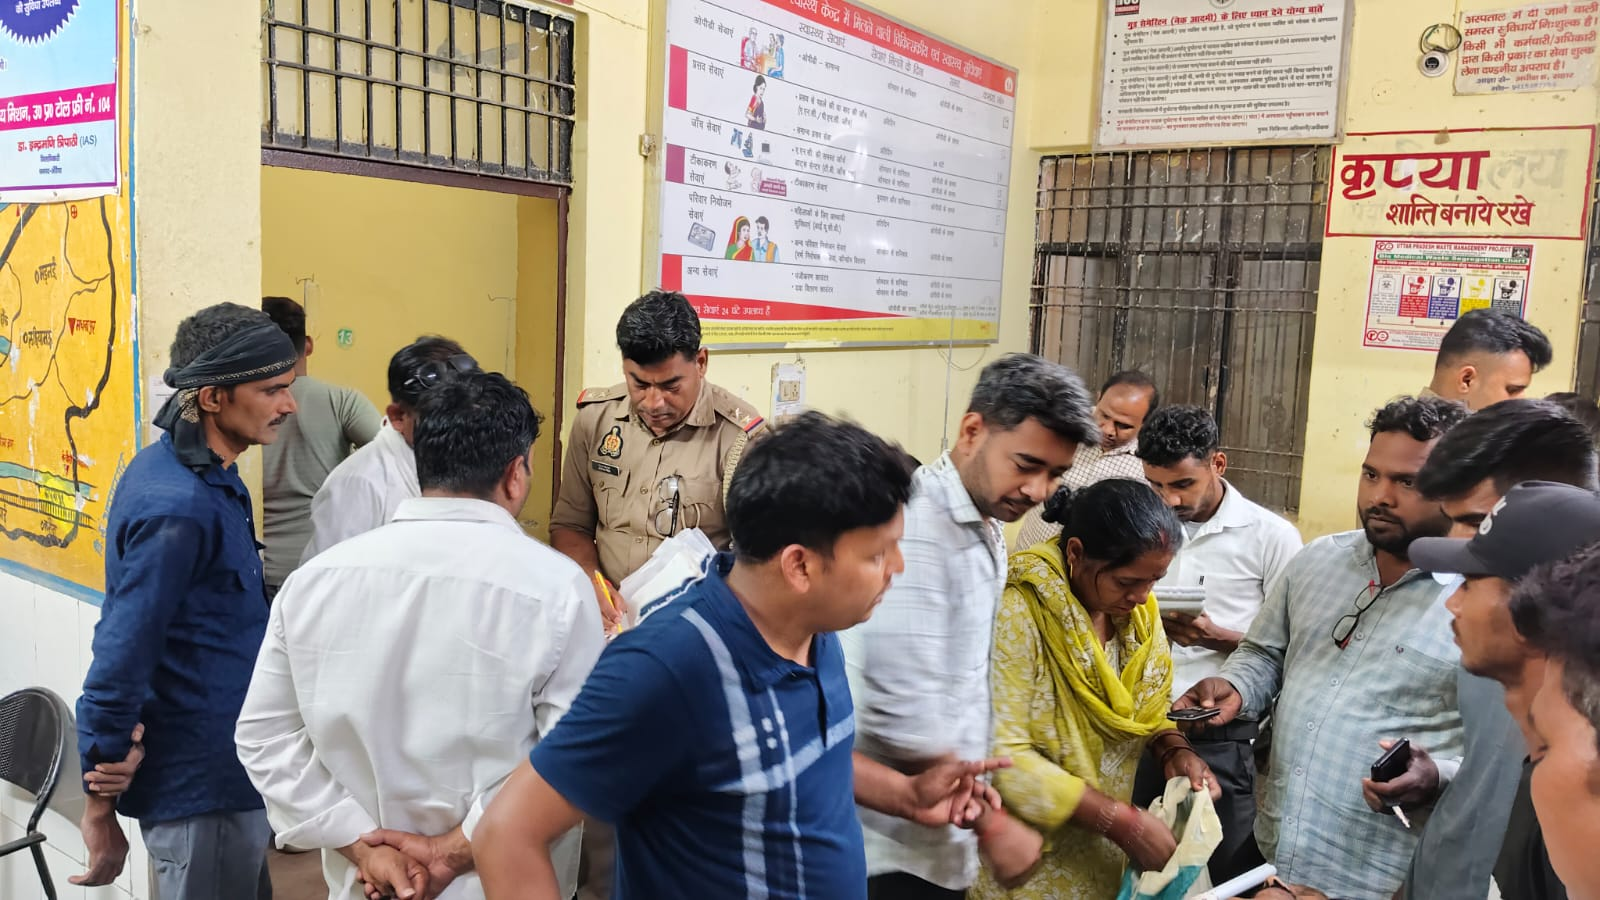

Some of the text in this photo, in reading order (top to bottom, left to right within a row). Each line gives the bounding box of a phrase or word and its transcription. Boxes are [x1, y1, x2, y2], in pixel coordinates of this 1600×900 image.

[1127, 21, 1138, 30] गुड
[1190, 13, 1217, 24] आदमी)
[1221, 11, 1229, 20] के
[1231, 11, 1247, 20] लिए
[1465, 13, 1506, 24] अस्पताल
[1544, 5, 1568, 16] जाने
[1574, 1, 1599, 13] वाली
[799, 22, 824, 40] स्वास्थ्य
[820, 1, 840, 23] केन्द्र
[853, 11, 873, 36] मिलने
[875, 23, 891, 44] वाली
[1464, 26, 1495, 37] समस्त
[1463, 40, 1486, 51] किसी
[1494, 38, 1505, 49] भी
[1462, 54, 1479, 64] द्वारा
[1481, 51, 1504, 63] किसी
[1534, 49, 1547, 58] का
[1550, 46, 1568, 57] सेवा
[1570, 46, 1595, 59] शुल्क
[1461, 66, 1479, 76] लेना
[1520, 62, 1551, 73] अपराध
[55, 97, 70, 118] टोल
[72, 94, 84, 117] फ्री
[98, 96, 111, 113] 104
[56, 133, 78, 149] त्रिपाठी
[79, 135, 97, 148] (IAS)
[690, 153, 717, 169] टीकाकरण
[689, 191, 732, 208] परिवार नियोजन
[1386, 194, 1536, 227] शान्ति बनाये रखे
[721, 308, 729, 316] 24
[338, 330, 353, 345] 13
